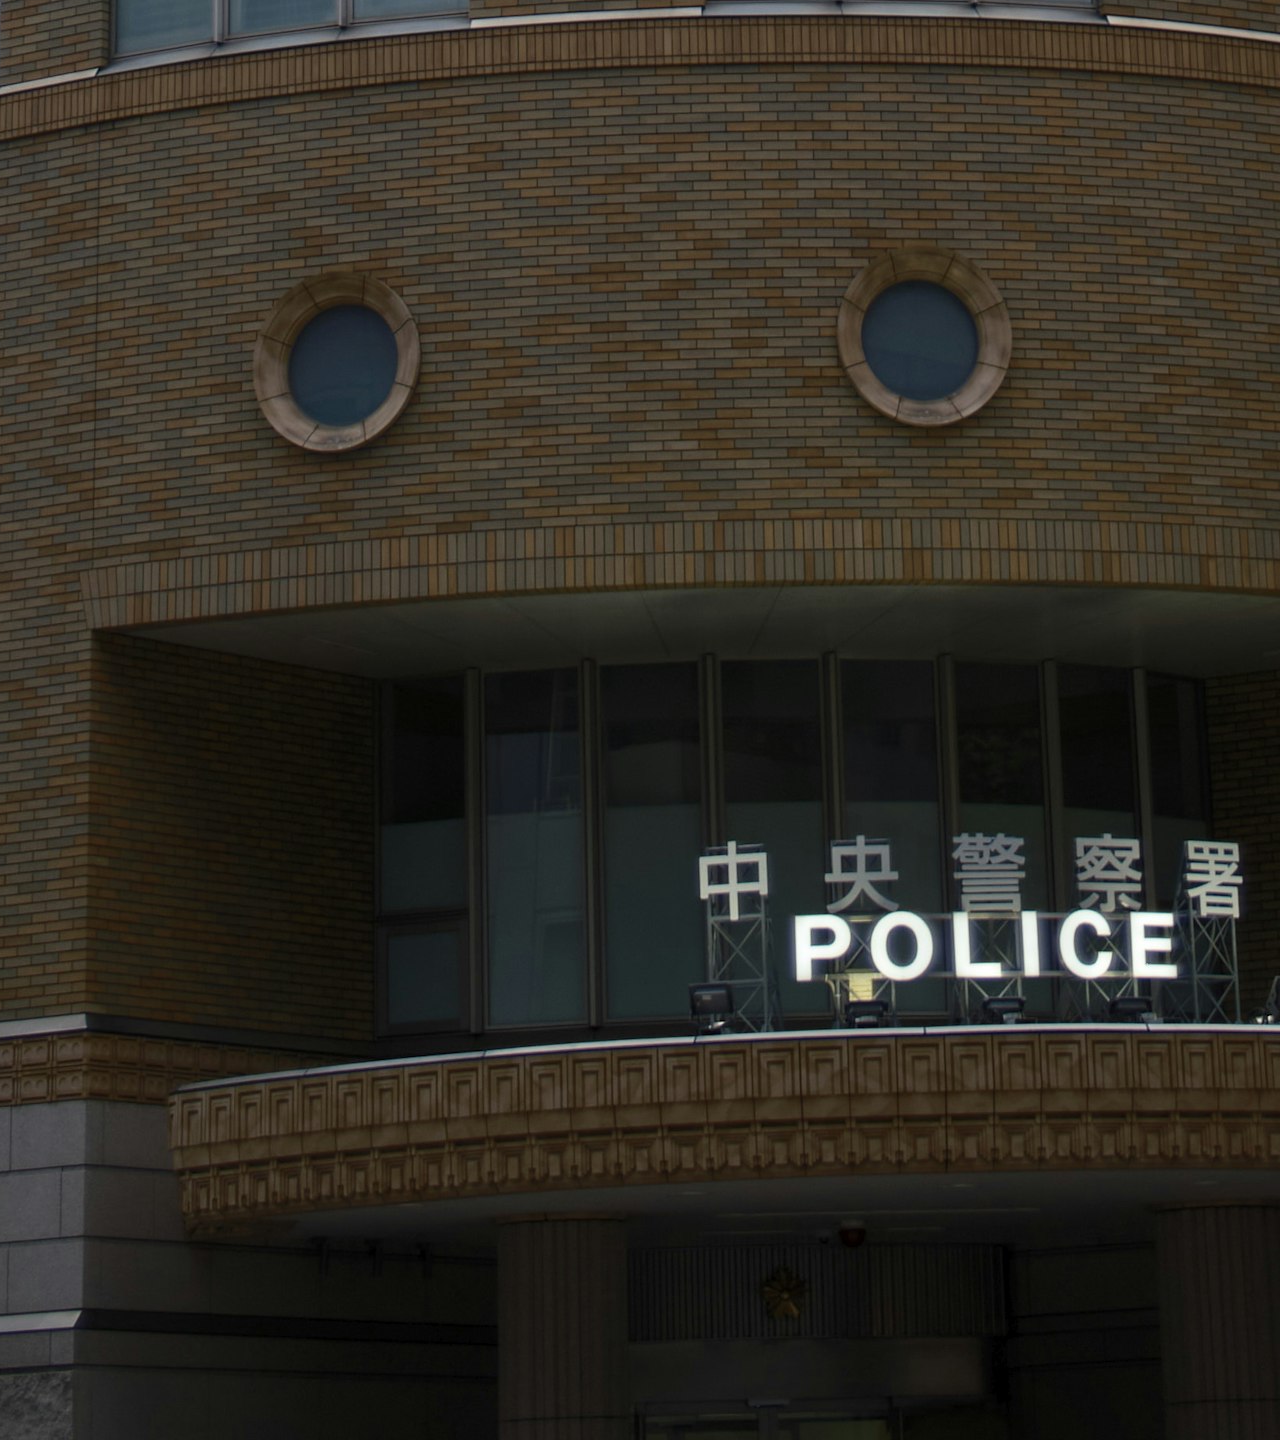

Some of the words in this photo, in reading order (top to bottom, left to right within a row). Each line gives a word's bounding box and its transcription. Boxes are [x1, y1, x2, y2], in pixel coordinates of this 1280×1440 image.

[698, 833, 1243, 920] 中央警察署
[792, 910, 1179, 982] POLICE
